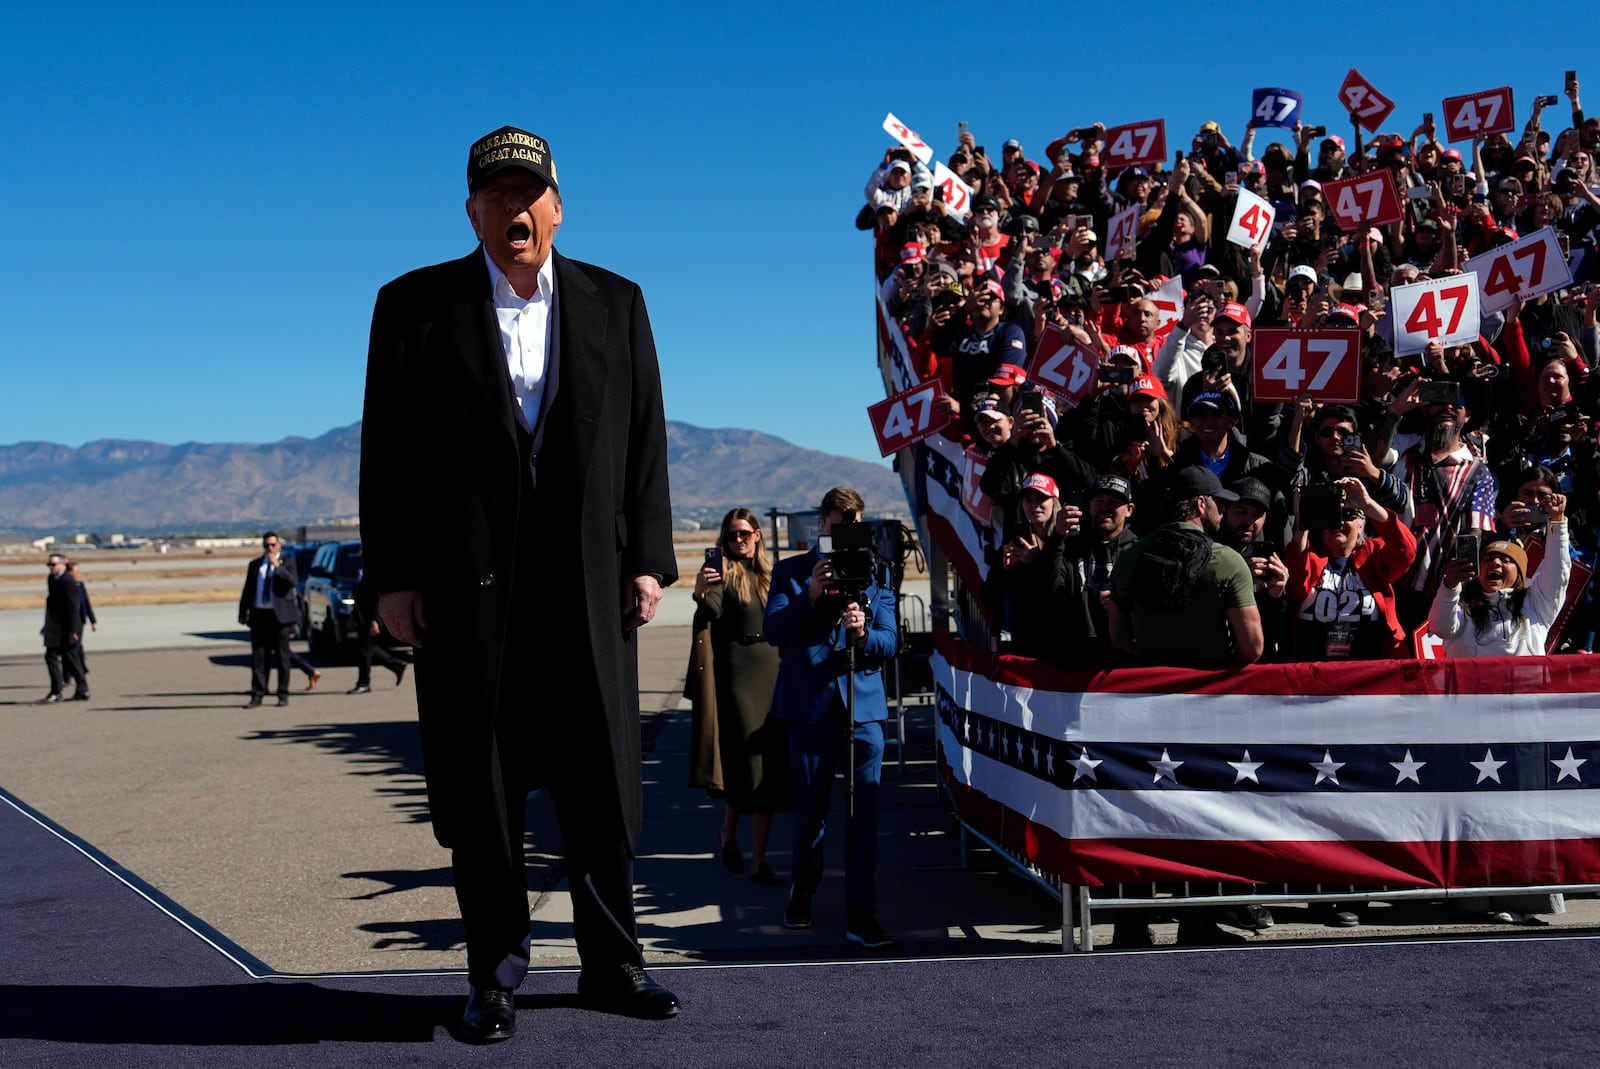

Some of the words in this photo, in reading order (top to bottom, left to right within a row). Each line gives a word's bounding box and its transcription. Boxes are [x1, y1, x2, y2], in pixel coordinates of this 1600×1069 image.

[1256, 95, 1298, 122] 47
[1345, 85, 1386, 118] 47
[1453, 94, 1503, 131] 47
[473, 135, 500, 158] MAKE
[501, 132, 546, 154] AMERICA
[479, 147, 510, 168] GREAT
[511, 148, 543, 165] AGAIN
[1110, 126, 1158, 160] 47
[941, 177, 966, 210] 47
[1336, 178, 1384, 222] 47
[1239, 204, 1271, 243] 47
[1484, 239, 1547, 297] 47
[1405, 284, 1469, 338] 47
[959, 337, 990, 355] USA
[1038, 345, 1091, 394] 47
[1261, 338, 1348, 390] 47
[882, 387, 935, 439] 47
[1299, 590, 1379, 623] 2024
